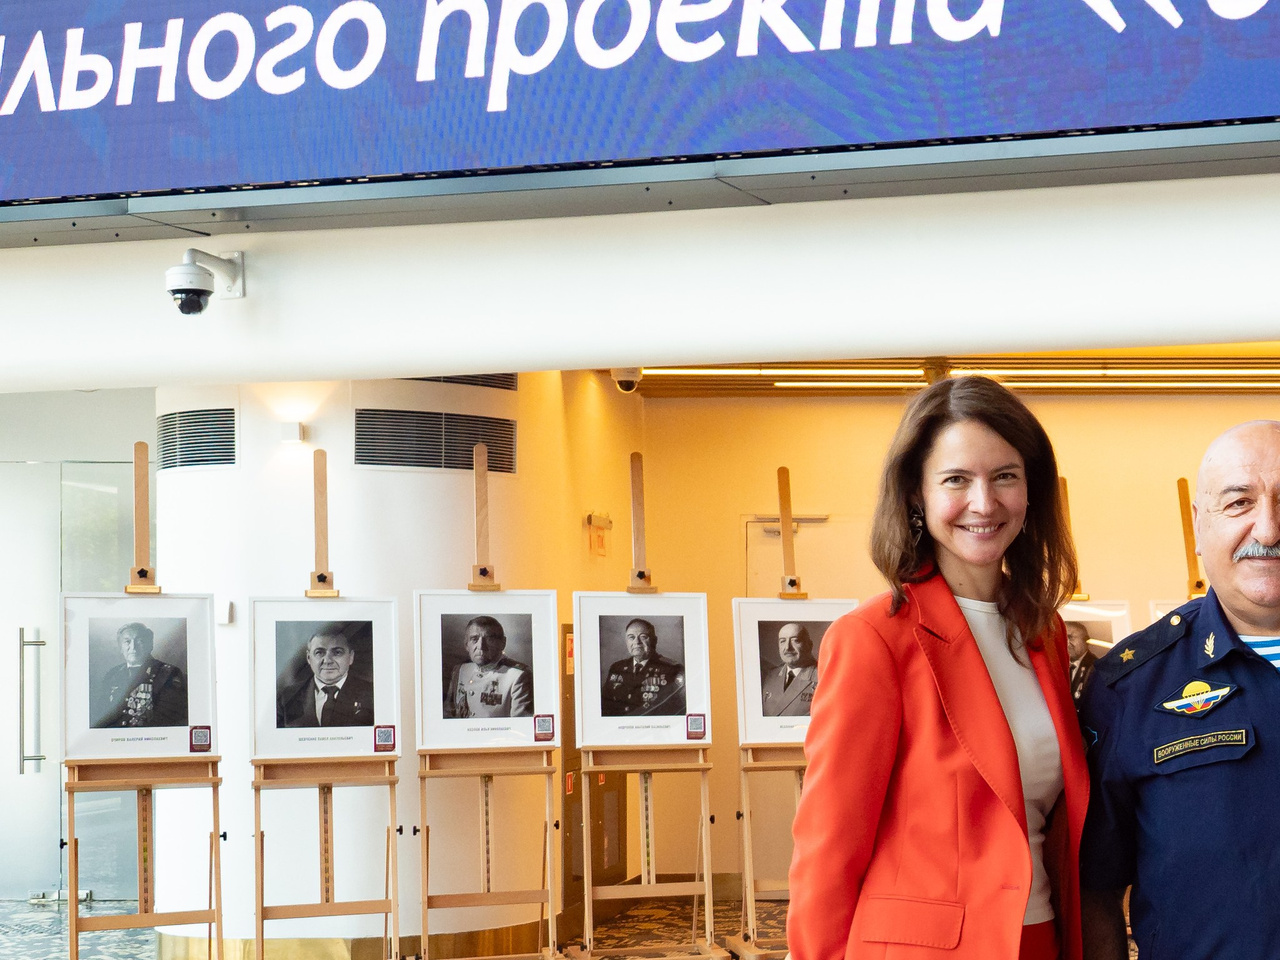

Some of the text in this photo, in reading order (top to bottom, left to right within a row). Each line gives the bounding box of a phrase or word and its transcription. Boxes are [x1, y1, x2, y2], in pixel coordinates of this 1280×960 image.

[0, 0, 387, 115] льного
[1158, 733, 1242, 758] ВООРУЖЕННЫЕ СИЛЫ РОССИИ
